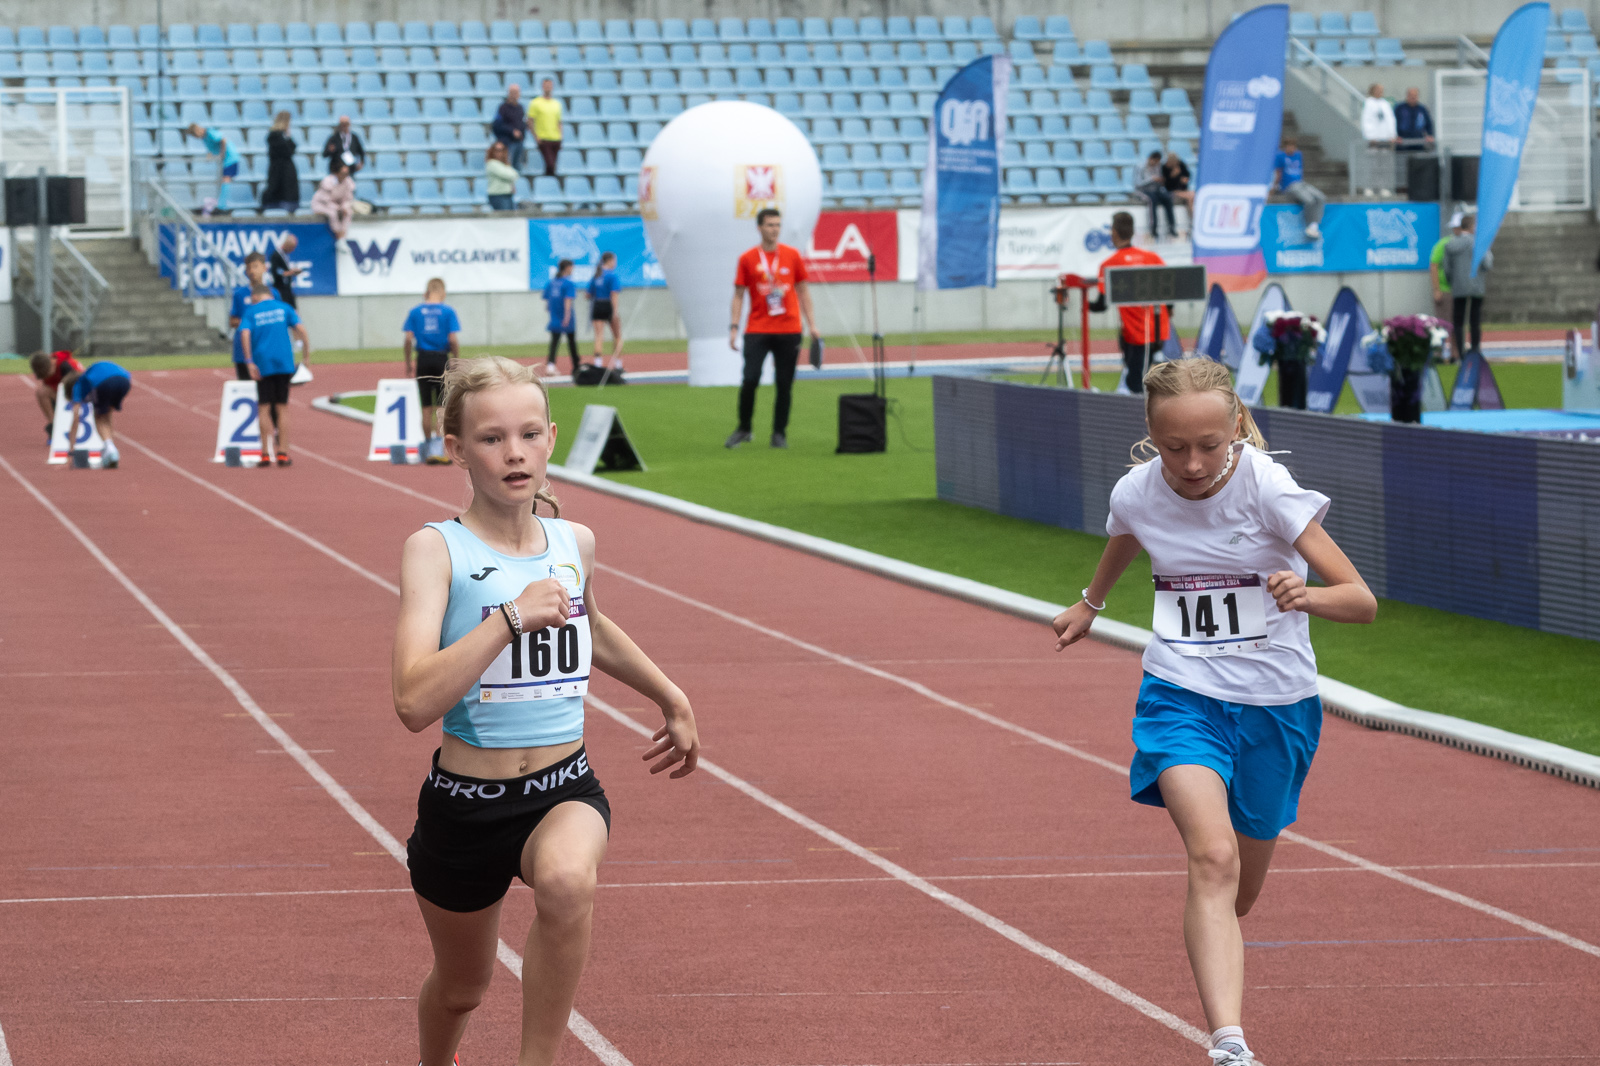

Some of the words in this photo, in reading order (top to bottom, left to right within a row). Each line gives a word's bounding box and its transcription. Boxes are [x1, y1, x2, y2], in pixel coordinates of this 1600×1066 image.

[64, 402, 92, 444] 3
[230, 398, 260, 442] 2
[387, 396, 407, 441] 1
[1177, 593, 1240, 637] 141
[511, 624, 579, 679] 160
[434, 773, 505, 799] PRO
[523, 752, 589, 795] NIKE
